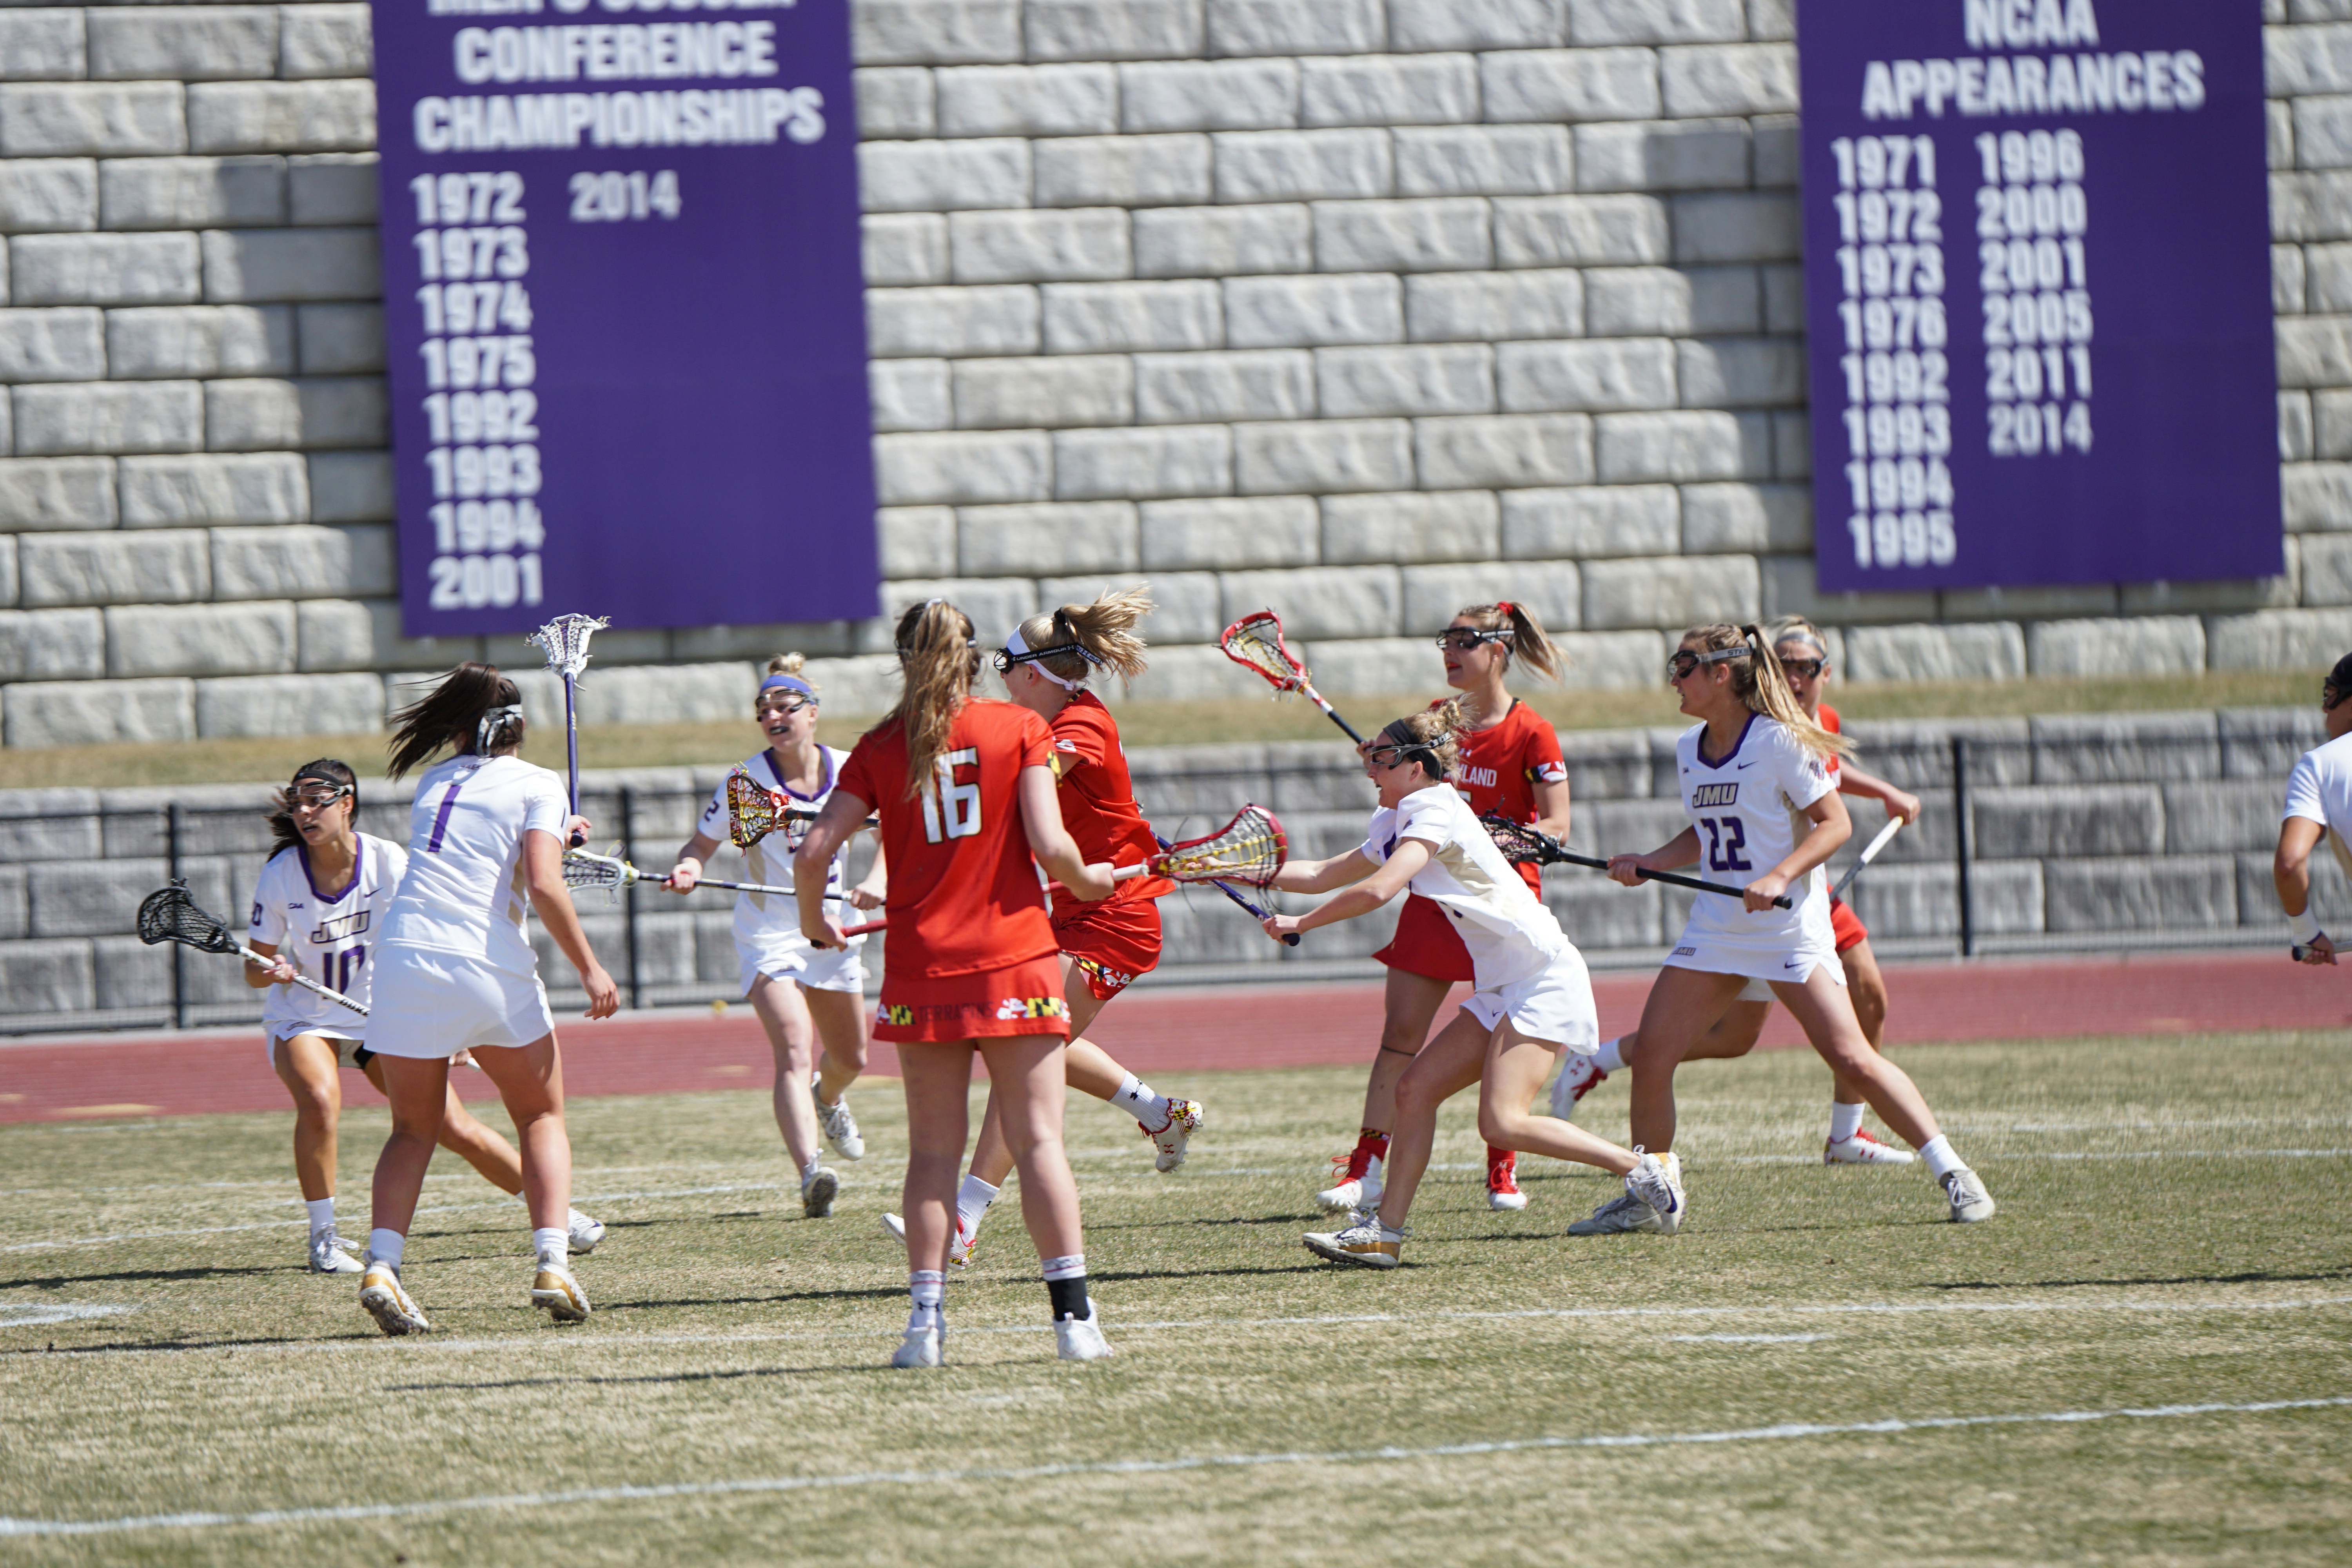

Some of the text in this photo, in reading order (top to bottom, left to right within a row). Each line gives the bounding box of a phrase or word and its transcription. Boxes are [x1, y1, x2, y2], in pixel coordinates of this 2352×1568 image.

[454, 20, 778, 83] CONFERENCE
[1862, 51, 2205, 119] APPEARANCES
[414, 86, 826, 152] CHAMPIONSHIPS
[1831, 135, 1936, 189] 1971
[1976, 129, 2084, 185] 1996
[411, 171, 526, 224] 1972
[570, 170, 681, 221] 2014
[1834, 188, 1942, 243] 1972
[1976, 182, 2087, 237] 2000
[414, 226, 529, 280] 1973
[1837, 242, 1945, 297] 1973
[1979, 236, 2086, 294] 2001
[417, 281, 534, 335] 1974
[1838, 295, 1948, 351] 1976
[1982, 290, 2093, 347] 2005
[420, 335, 536, 389] 1975
[1840, 348, 1950, 405] 1992
[1985, 343, 2092, 400] 2011
[423, 388, 539, 444] 1992
[1842, 402, 1952, 458] 1993
[1987, 401, 2092, 455] 2014
[426, 443, 542, 499] 1993
[1846, 457, 1955, 512] 1994
[430, 498, 545, 553] 1994
[1847, 510, 1957, 567] 1995
[430, 553, 543, 609] 2001
[1038, 647, 1067, 656] ARMOUR
[428, 784, 462, 852] 1
[919, 746, 982, 844] 16
[1692, 783, 1739, 808] JMU
[1700, 816, 1753, 871] 22
[311, 910, 370, 944] JMU
